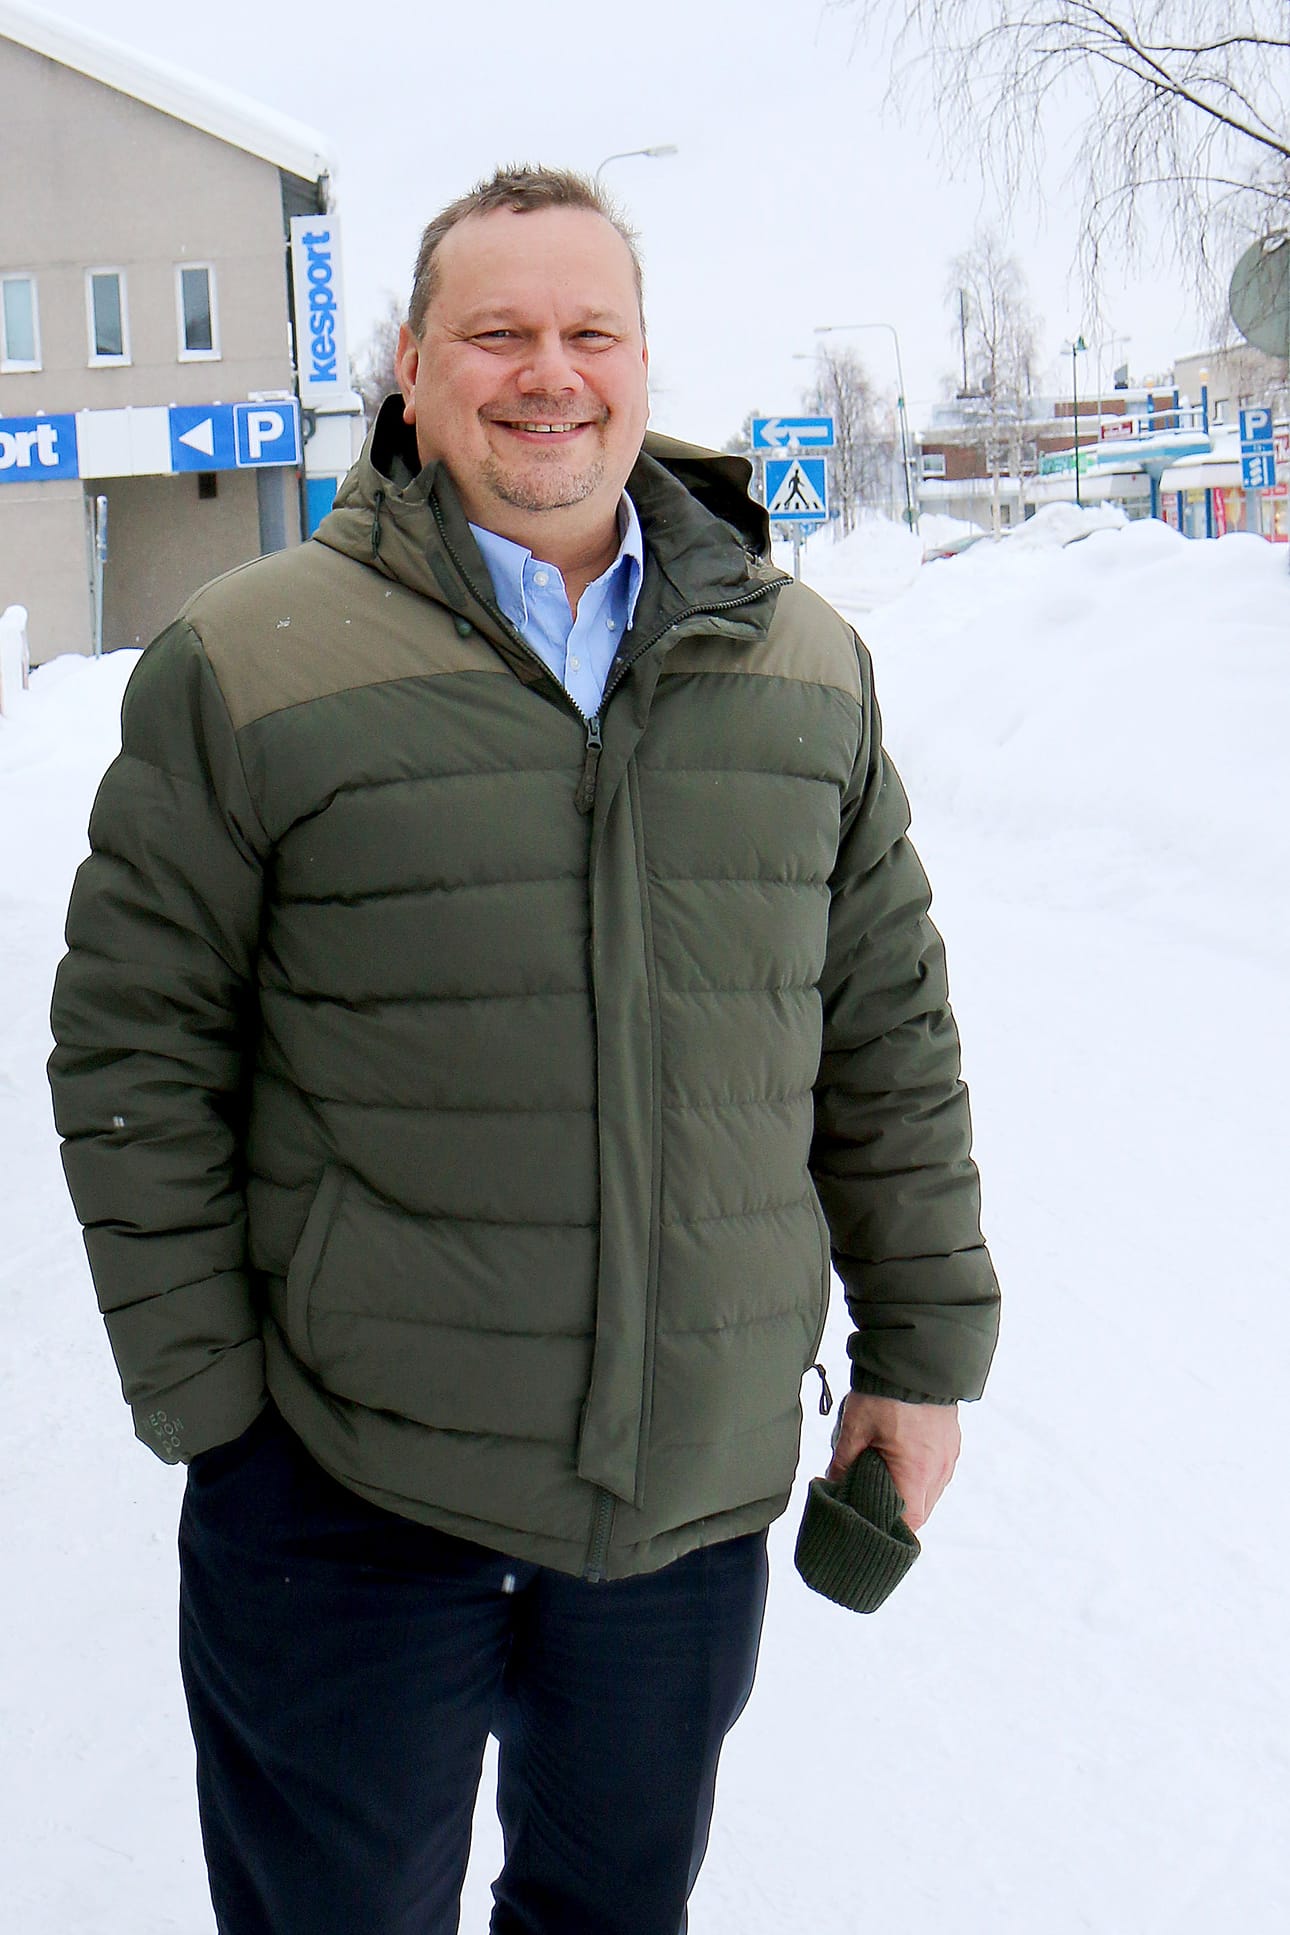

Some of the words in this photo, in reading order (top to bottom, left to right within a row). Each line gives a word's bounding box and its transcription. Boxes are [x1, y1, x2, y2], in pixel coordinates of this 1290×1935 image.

[302, 230, 338, 383] kesport
[247, 411, 284, 459] P
[1244, 409, 1268, 440] P
